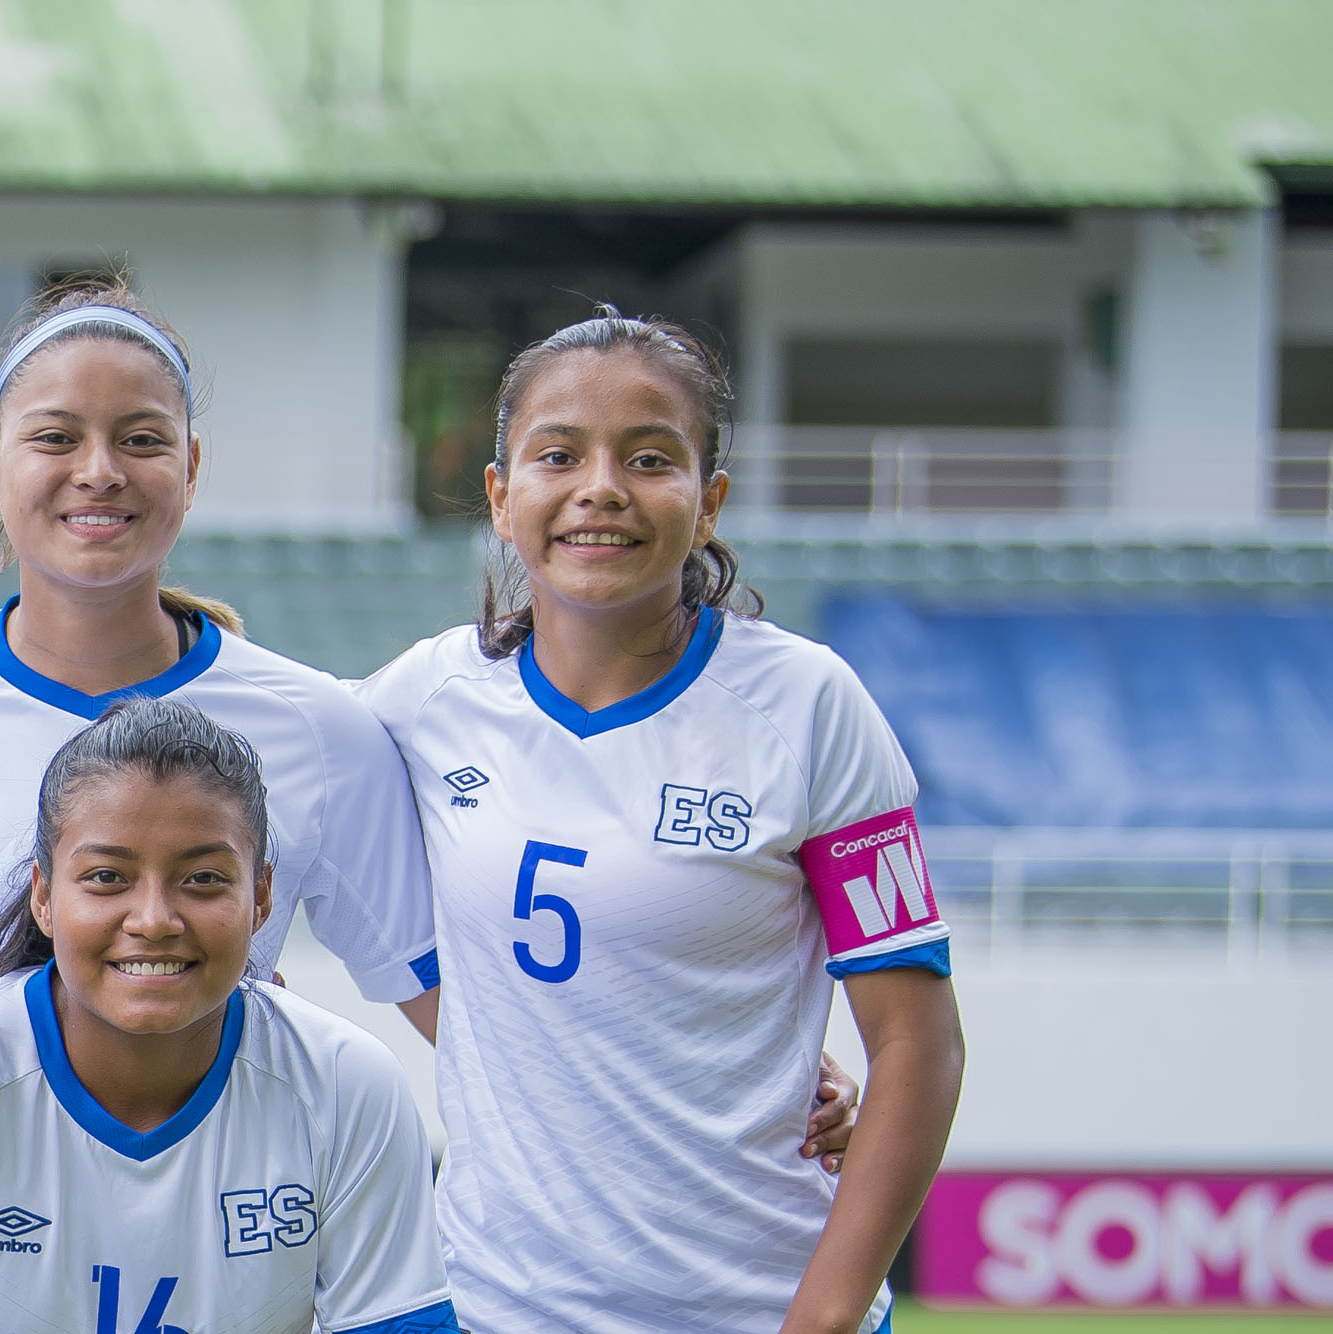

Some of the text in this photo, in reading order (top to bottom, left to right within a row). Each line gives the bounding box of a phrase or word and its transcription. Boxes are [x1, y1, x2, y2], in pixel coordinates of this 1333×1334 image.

[451, 795, 478, 808] umbro
[654, 783, 753, 851] ES
[830, 821, 909, 858] Concacaf
[512, 840, 588, 983] 5
[220, 1183, 318, 1257] ES
